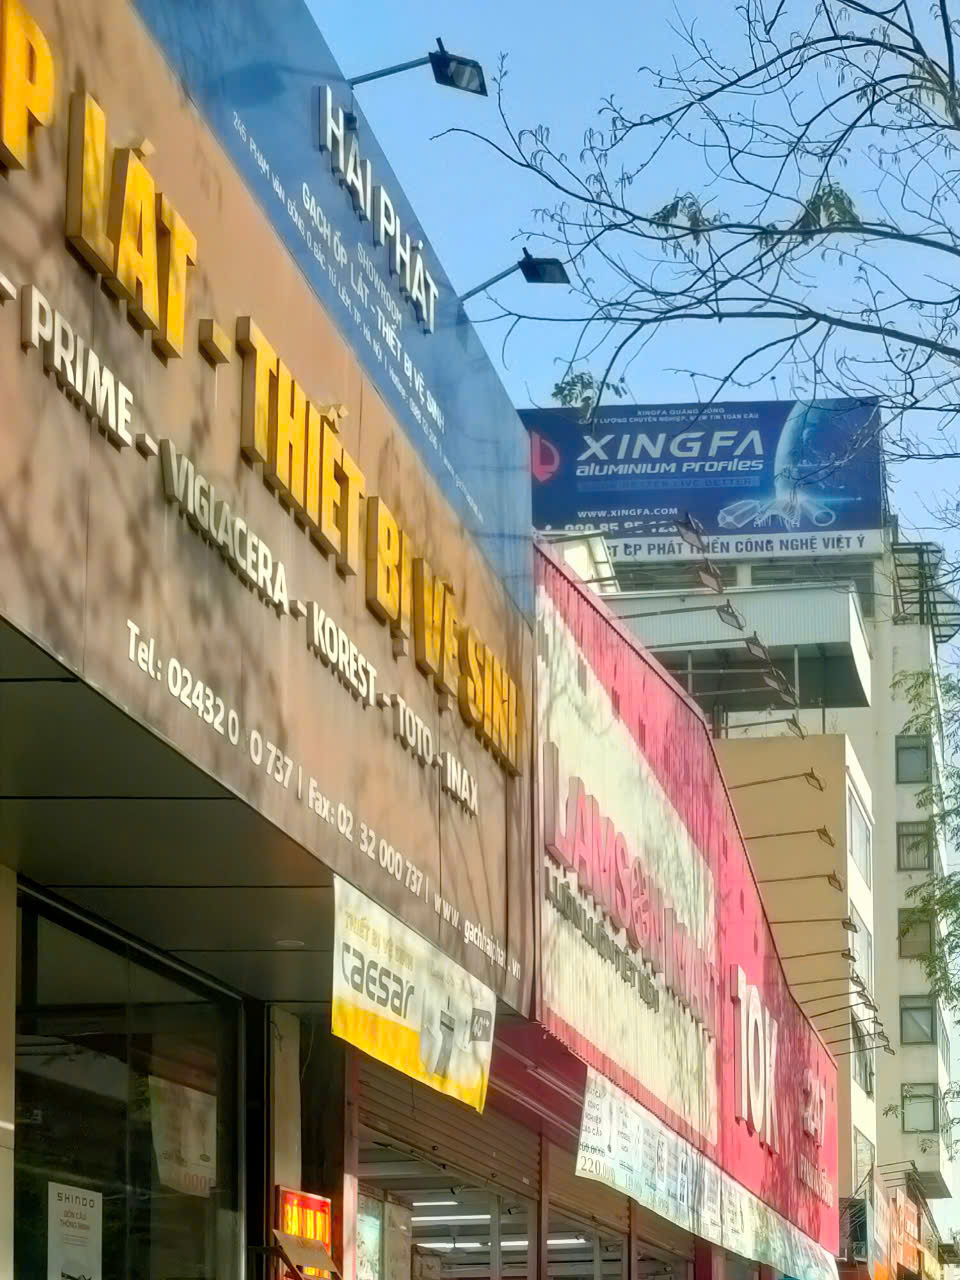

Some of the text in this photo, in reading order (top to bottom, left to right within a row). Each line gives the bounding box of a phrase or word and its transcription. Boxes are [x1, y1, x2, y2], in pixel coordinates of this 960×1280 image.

[302, 182, 332, 247] GẠCH
[333, 231, 347, 268] ỐP
[350, 262, 370, 308] LÁT
[375, 304, 402, 363] THIẾT
[357, 242, 403, 330] SHOWROOM
[577, 430, 765, 461] XINGFA
[577, 507, 678, 518] WWW.XINGFA.COM
[21, 283, 135, 449] PRIME
[161, 438, 290, 615] VIGLACERA
[307, 600, 378, 707] KOREST
[393, 693, 434, 766] TOTO
[441, 750, 480, 817] INAX
[237, 316, 366, 576] THIẾT
[367, 496, 410, 656] BỊ
[457, 625, 524, 776] SINH
[651, 539, 684, 556] PHÁT
[735, 535, 775, 553] CÔNG
[779, 534, 818, 555] NGHỆ
[822, 533, 851, 552] VIỆT
[856, 531, 866, 548] Ý
[126, 619, 162, 682] Tel:
[308, 775, 335, 824] Fax:
